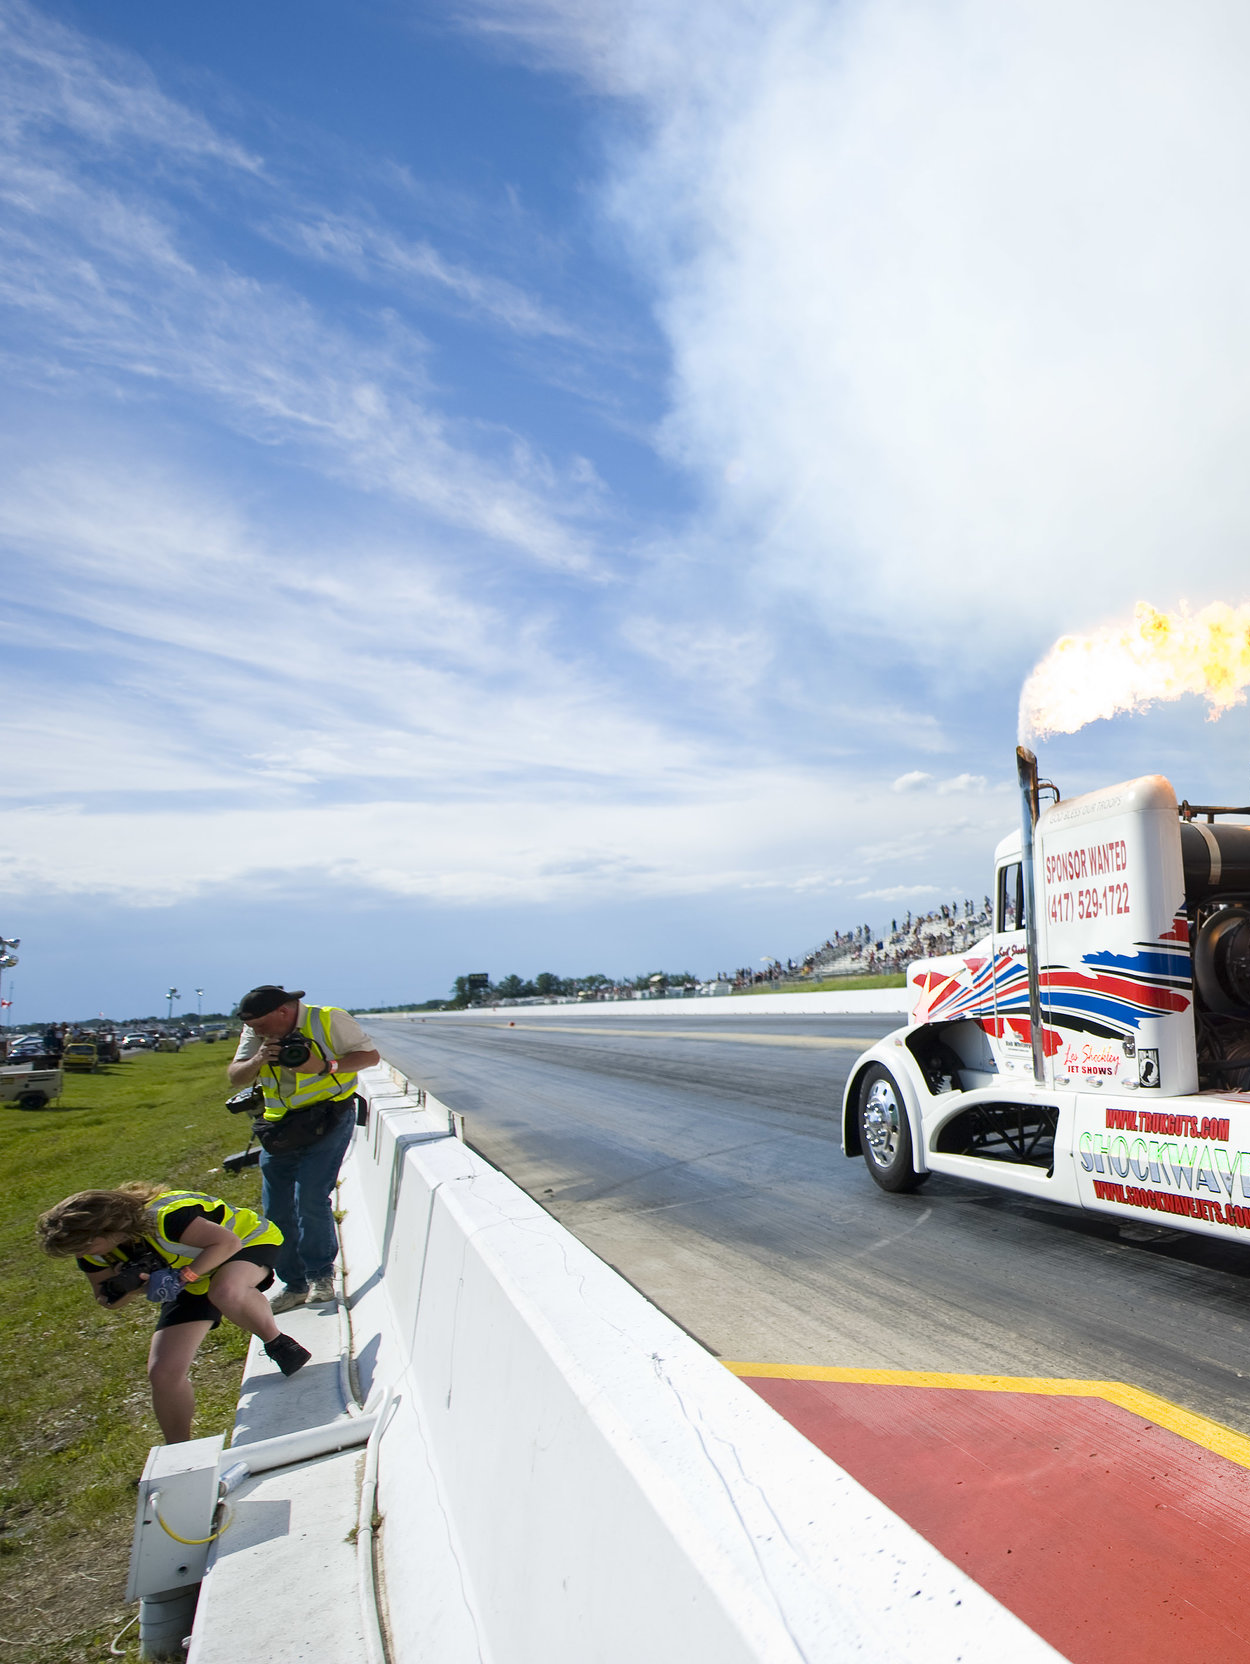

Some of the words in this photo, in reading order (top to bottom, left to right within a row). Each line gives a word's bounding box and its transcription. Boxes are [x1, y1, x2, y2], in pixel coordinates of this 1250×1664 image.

[1046, 849, 1088, 884] SPONSOR
[1088, 840, 1127, 876] WANTED
[1048, 891, 1075, 926] (417)
[1078, 882, 1130, 920] 529-1722
[1064, 1043, 1078, 1065] Les
[1067, 1065, 1079, 1073] JET
[1081, 1065, 1113, 1075] SHOWS
[1105, 1108, 1231, 1141] WWW.TRUKGUTS.COM
